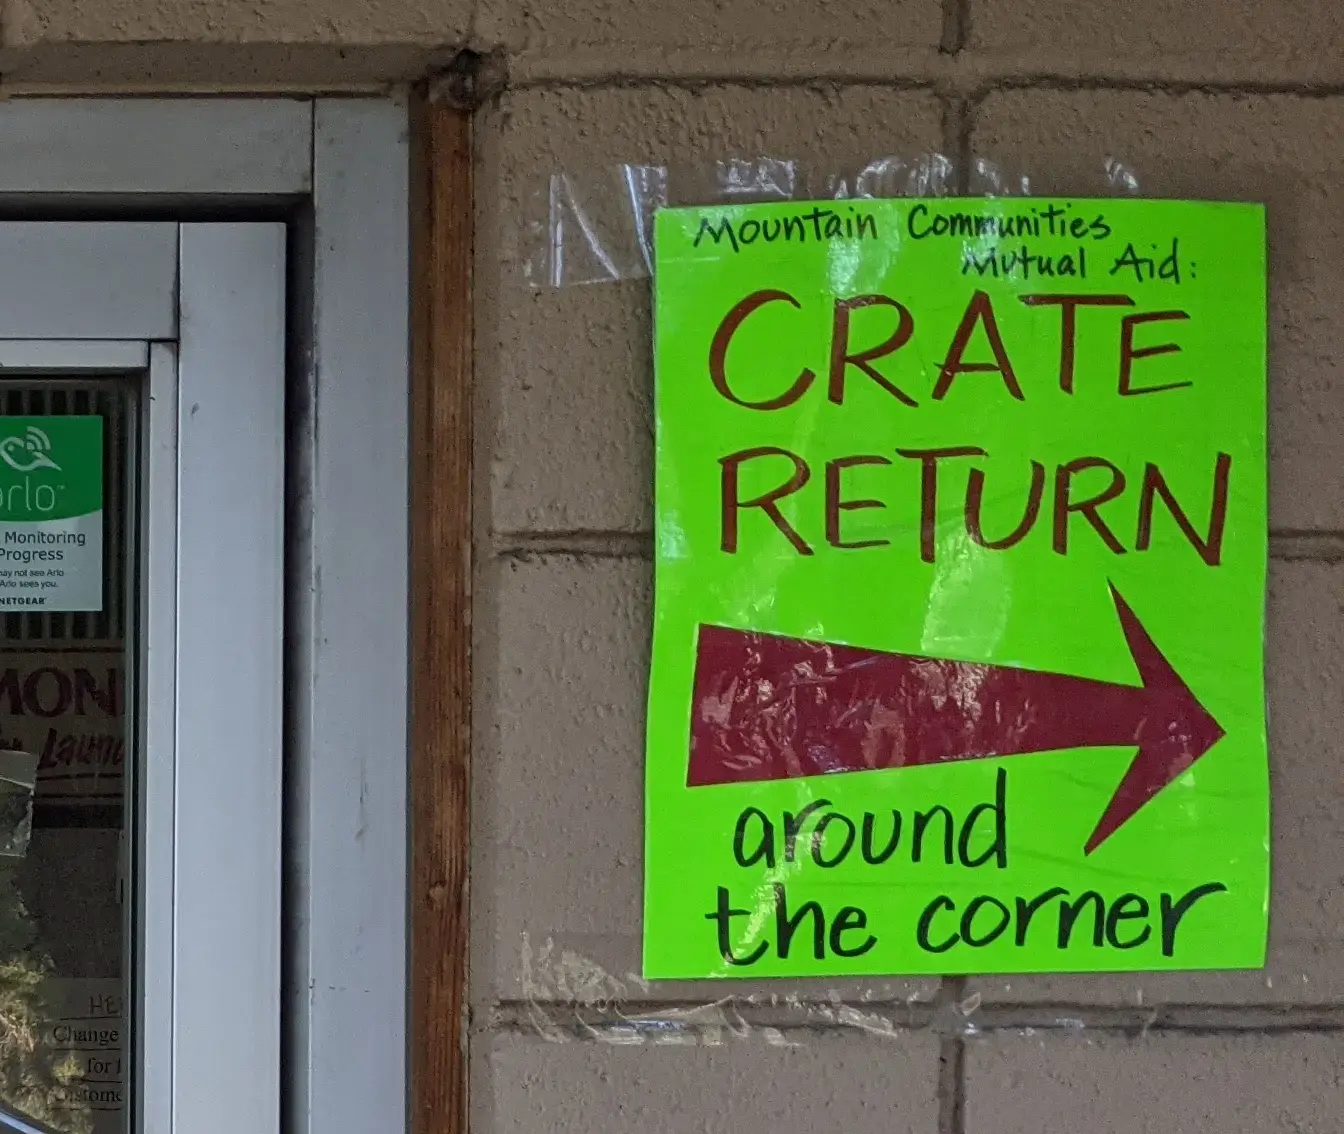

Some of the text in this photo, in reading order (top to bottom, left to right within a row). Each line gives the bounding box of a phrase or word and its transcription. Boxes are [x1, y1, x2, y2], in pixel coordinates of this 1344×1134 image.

[693, 203, 1112, 251] Mountain Communities
[962, 237, 1198, 284] Mutual Aid:
[709, 288, 1193, 411] CRATE
[717, 445, 1231, 567] RETURN
[4, 530, 86, 547] Monitoring
[0, 580, 16, 588] Arlo
[14, 569, 28, 577] not
[47, 569, 64, 577] Arlo
[732, 767, 1007, 869] around
[705, 882, 1228, 966] the corner
